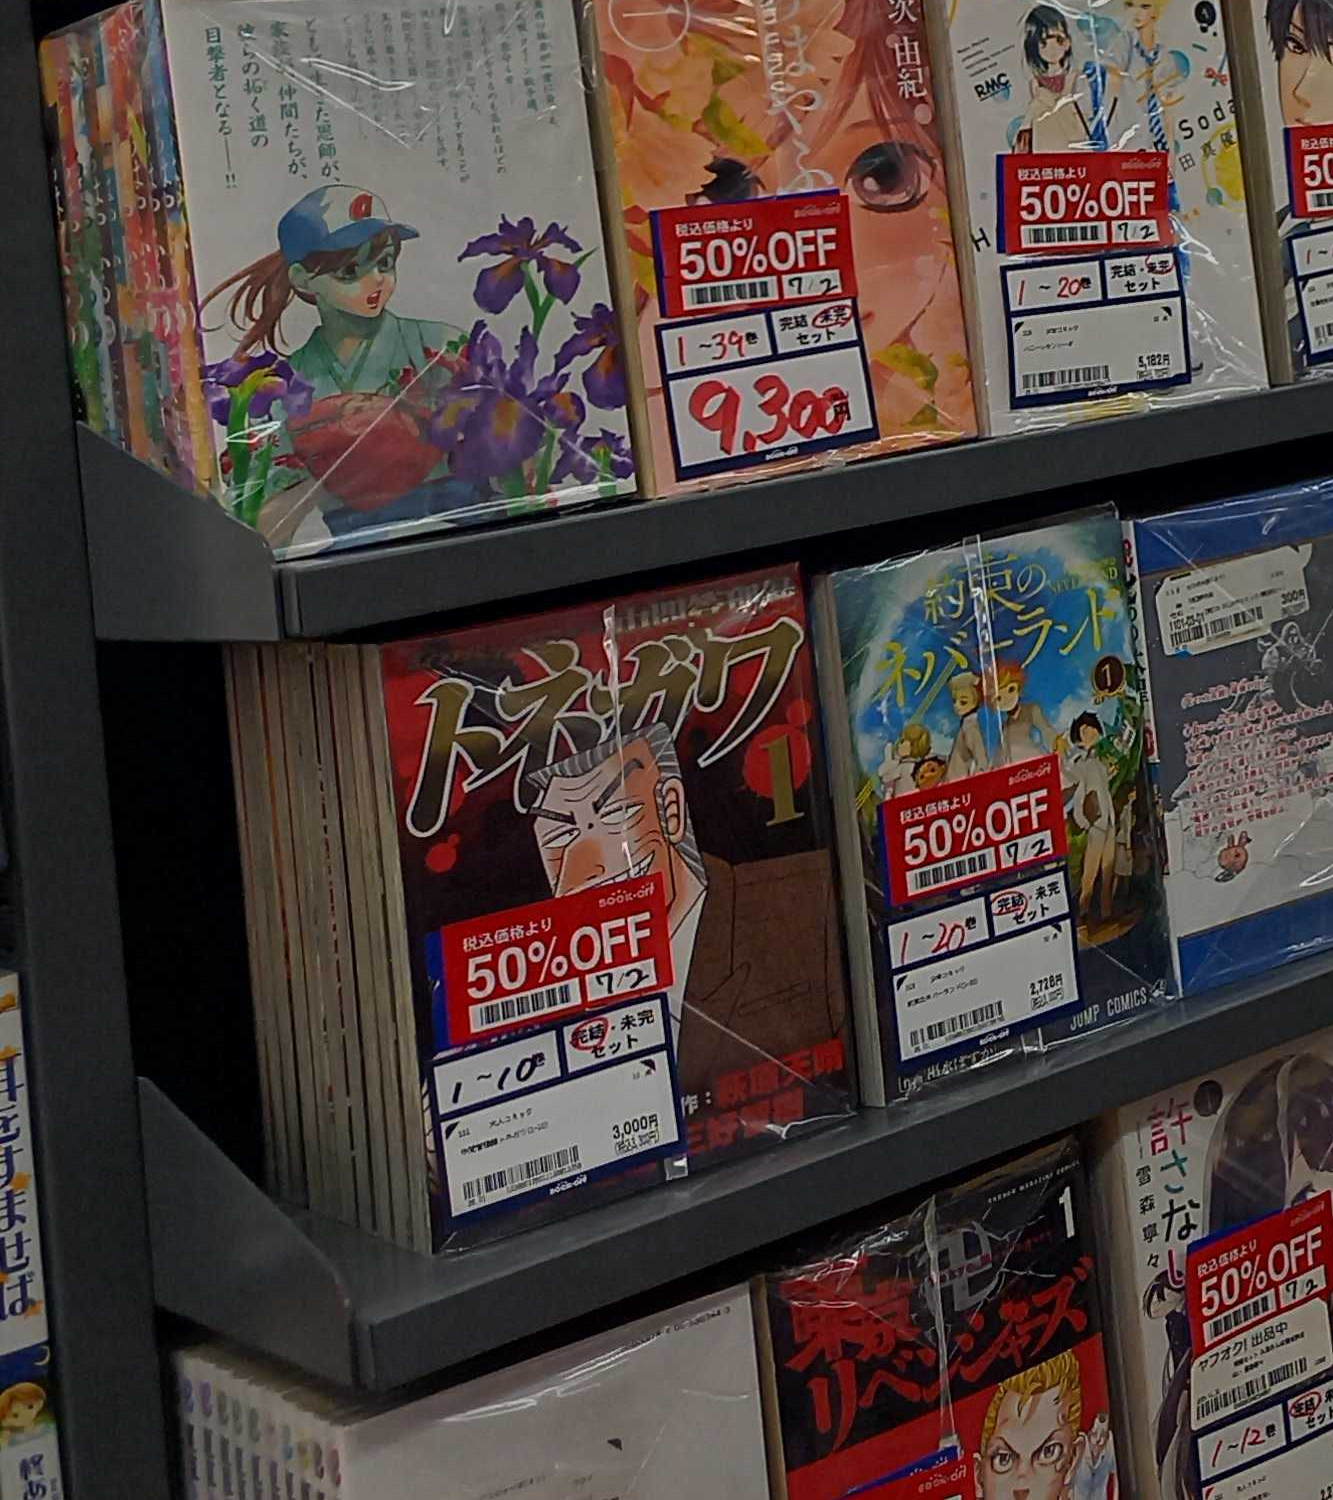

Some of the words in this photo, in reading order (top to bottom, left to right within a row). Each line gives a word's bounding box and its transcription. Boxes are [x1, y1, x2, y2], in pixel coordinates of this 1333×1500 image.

[974, 71, 1011, 102] RMC
[1017, 165, 1087, 181] 税込価格より
[1018, 181, 1157, 222] 50%OFF
[675, 218, 754, 239] 税込価格より
[679, 227, 838, 281] 50%OFF
[1123, 278, 1161, 294] セット
[796, 329, 837, 346] セット
[406, 615, 805, 838] トネガワ
[763, 733, 806, 828] 1
[900, 792, 972, 826] 税込価格より
[904, 788, 1051, 868] 50%OFF
[1012, 903, 1051, 926] セット
[462, 917, 553, 954] 税込価格より
[466, 910, 653, 1000] 50%OFF
[595, 965, 651, 997] 7/2
[1069, 1003, 1101, 1032] JUMP
[1107, 987, 1148, 1018] COMICS
[590, 1033, 640, 1059] セット
[611, 1114, 660, 1140] 3,000円
[1058, 1186, 1076, 1238] 1
[1200, 1226, 1324, 1318] 50%OFF
[1250, 1321, 1289, 1348] 出品中
